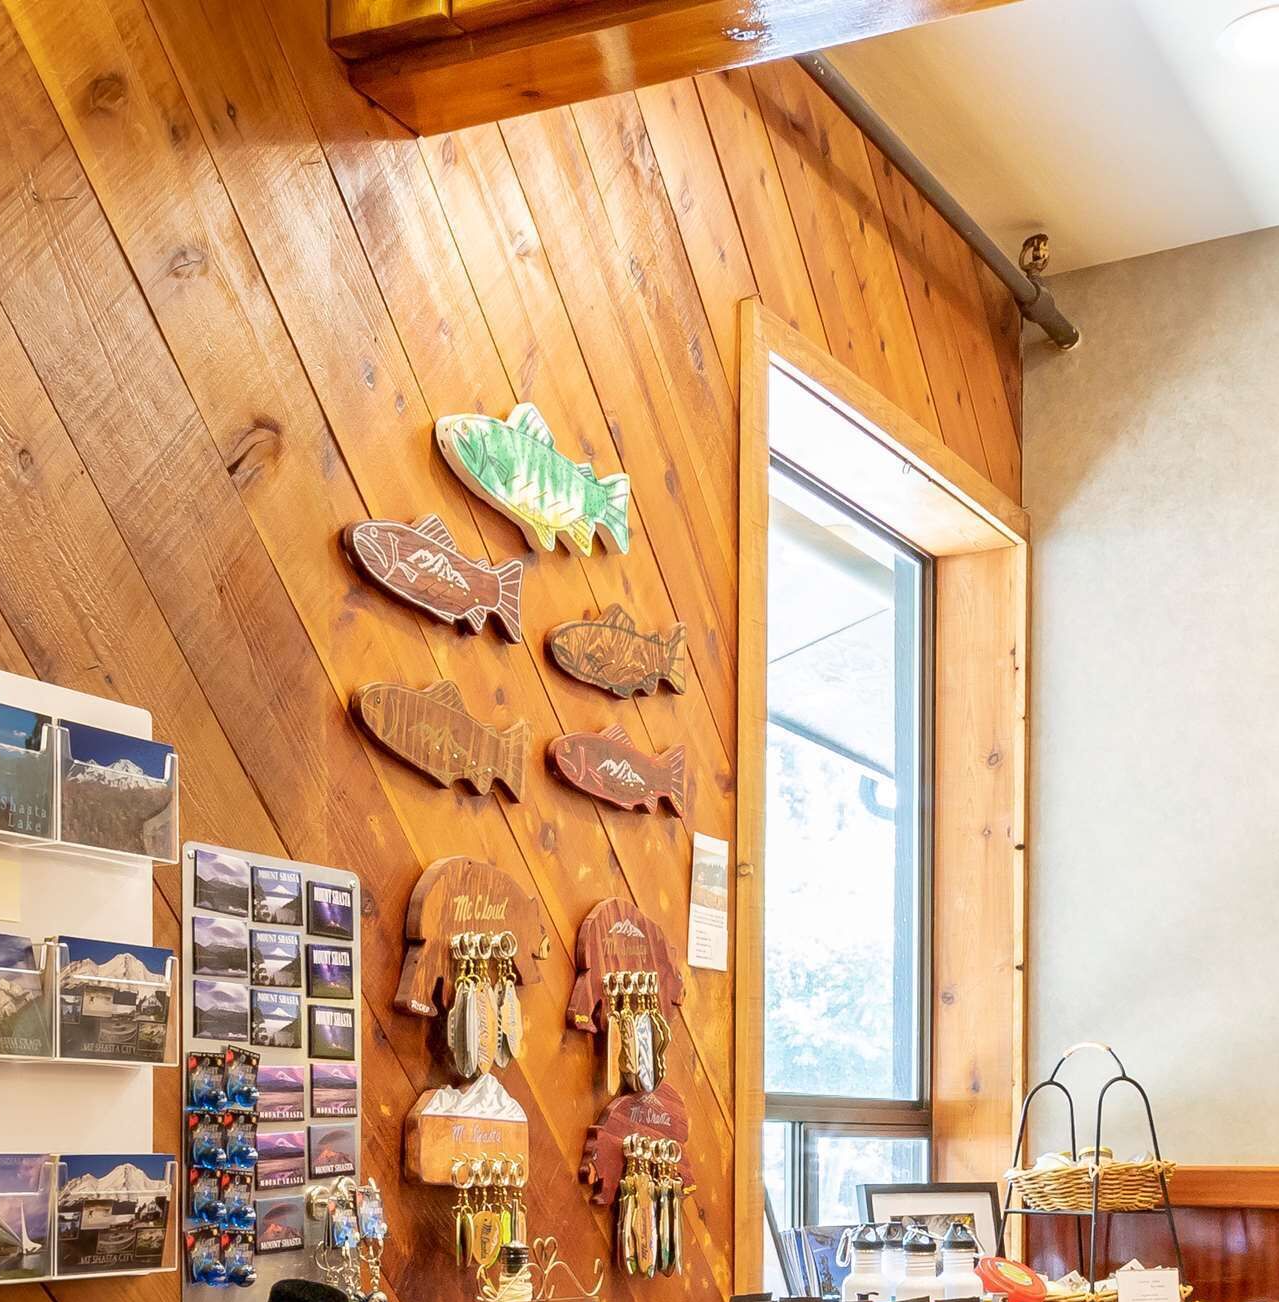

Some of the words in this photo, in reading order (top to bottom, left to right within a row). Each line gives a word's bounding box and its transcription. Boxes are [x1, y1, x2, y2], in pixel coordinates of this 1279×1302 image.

[0, 791, 47, 819] Shasta
[7, 812, 42, 833] Lake
[258, 869, 278, 881] MOUNT
[279, 871, 300, 884] SHASTA
[313, 886, 334, 904] MOUNT
[334, 889, 351, 907] SHASTA
[256, 932, 277, 944] MOUNT
[277, 934, 298, 946] SHASTA
[312, 949, 333, 965] MOUNT
[333, 951, 351, 967] SHASTA
[257, 992, 278, 1004] MOUNT
[278, 994, 299, 1006] SHASTA
[315, 1009, 334, 1026] MOUNT
[334, 1012, 353, 1028] SHASTA
[259, 1111, 279, 1119] MOUNT
[280, 1110, 304, 1119] SHASTA
[315, 1107, 335, 1115] MOUNT
[335, 1106, 357, 1115] SHASTA
[314, 1165, 335, 1175] MOUNT
[335, 1162, 355, 1173] SHASTA
[259, 1178, 279, 1187] MOUNT
[279, 1176, 304, 1186] SHASTA
[260, 1240, 280, 1251] MOUNT
[280, 1236, 302, 1248] SHASTA
